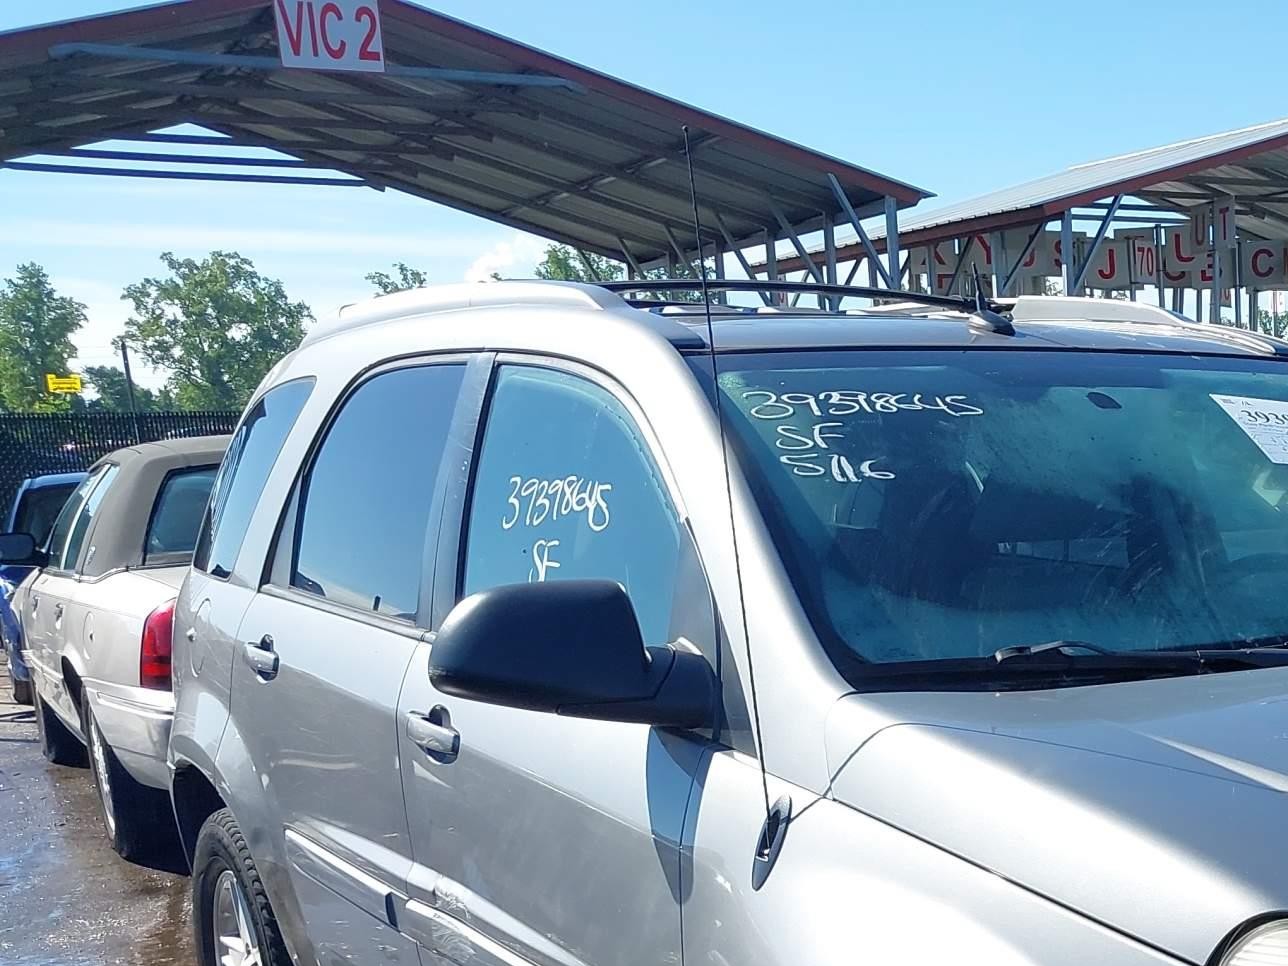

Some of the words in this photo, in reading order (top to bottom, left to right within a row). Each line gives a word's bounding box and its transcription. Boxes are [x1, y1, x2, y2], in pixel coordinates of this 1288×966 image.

[277, 0, 346, 59] VIC
[355, 6, 380, 60] 2
[1195, 213, 1205, 246] U
[1219, 207, 1229, 240] T
[1098, 249, 1115, 279] J
[1137, 246, 1153, 276] 70
[1251, 248, 1274, 278] C
[776, 422, 845, 450] SF
[502, 475, 612, 532] 39398645
